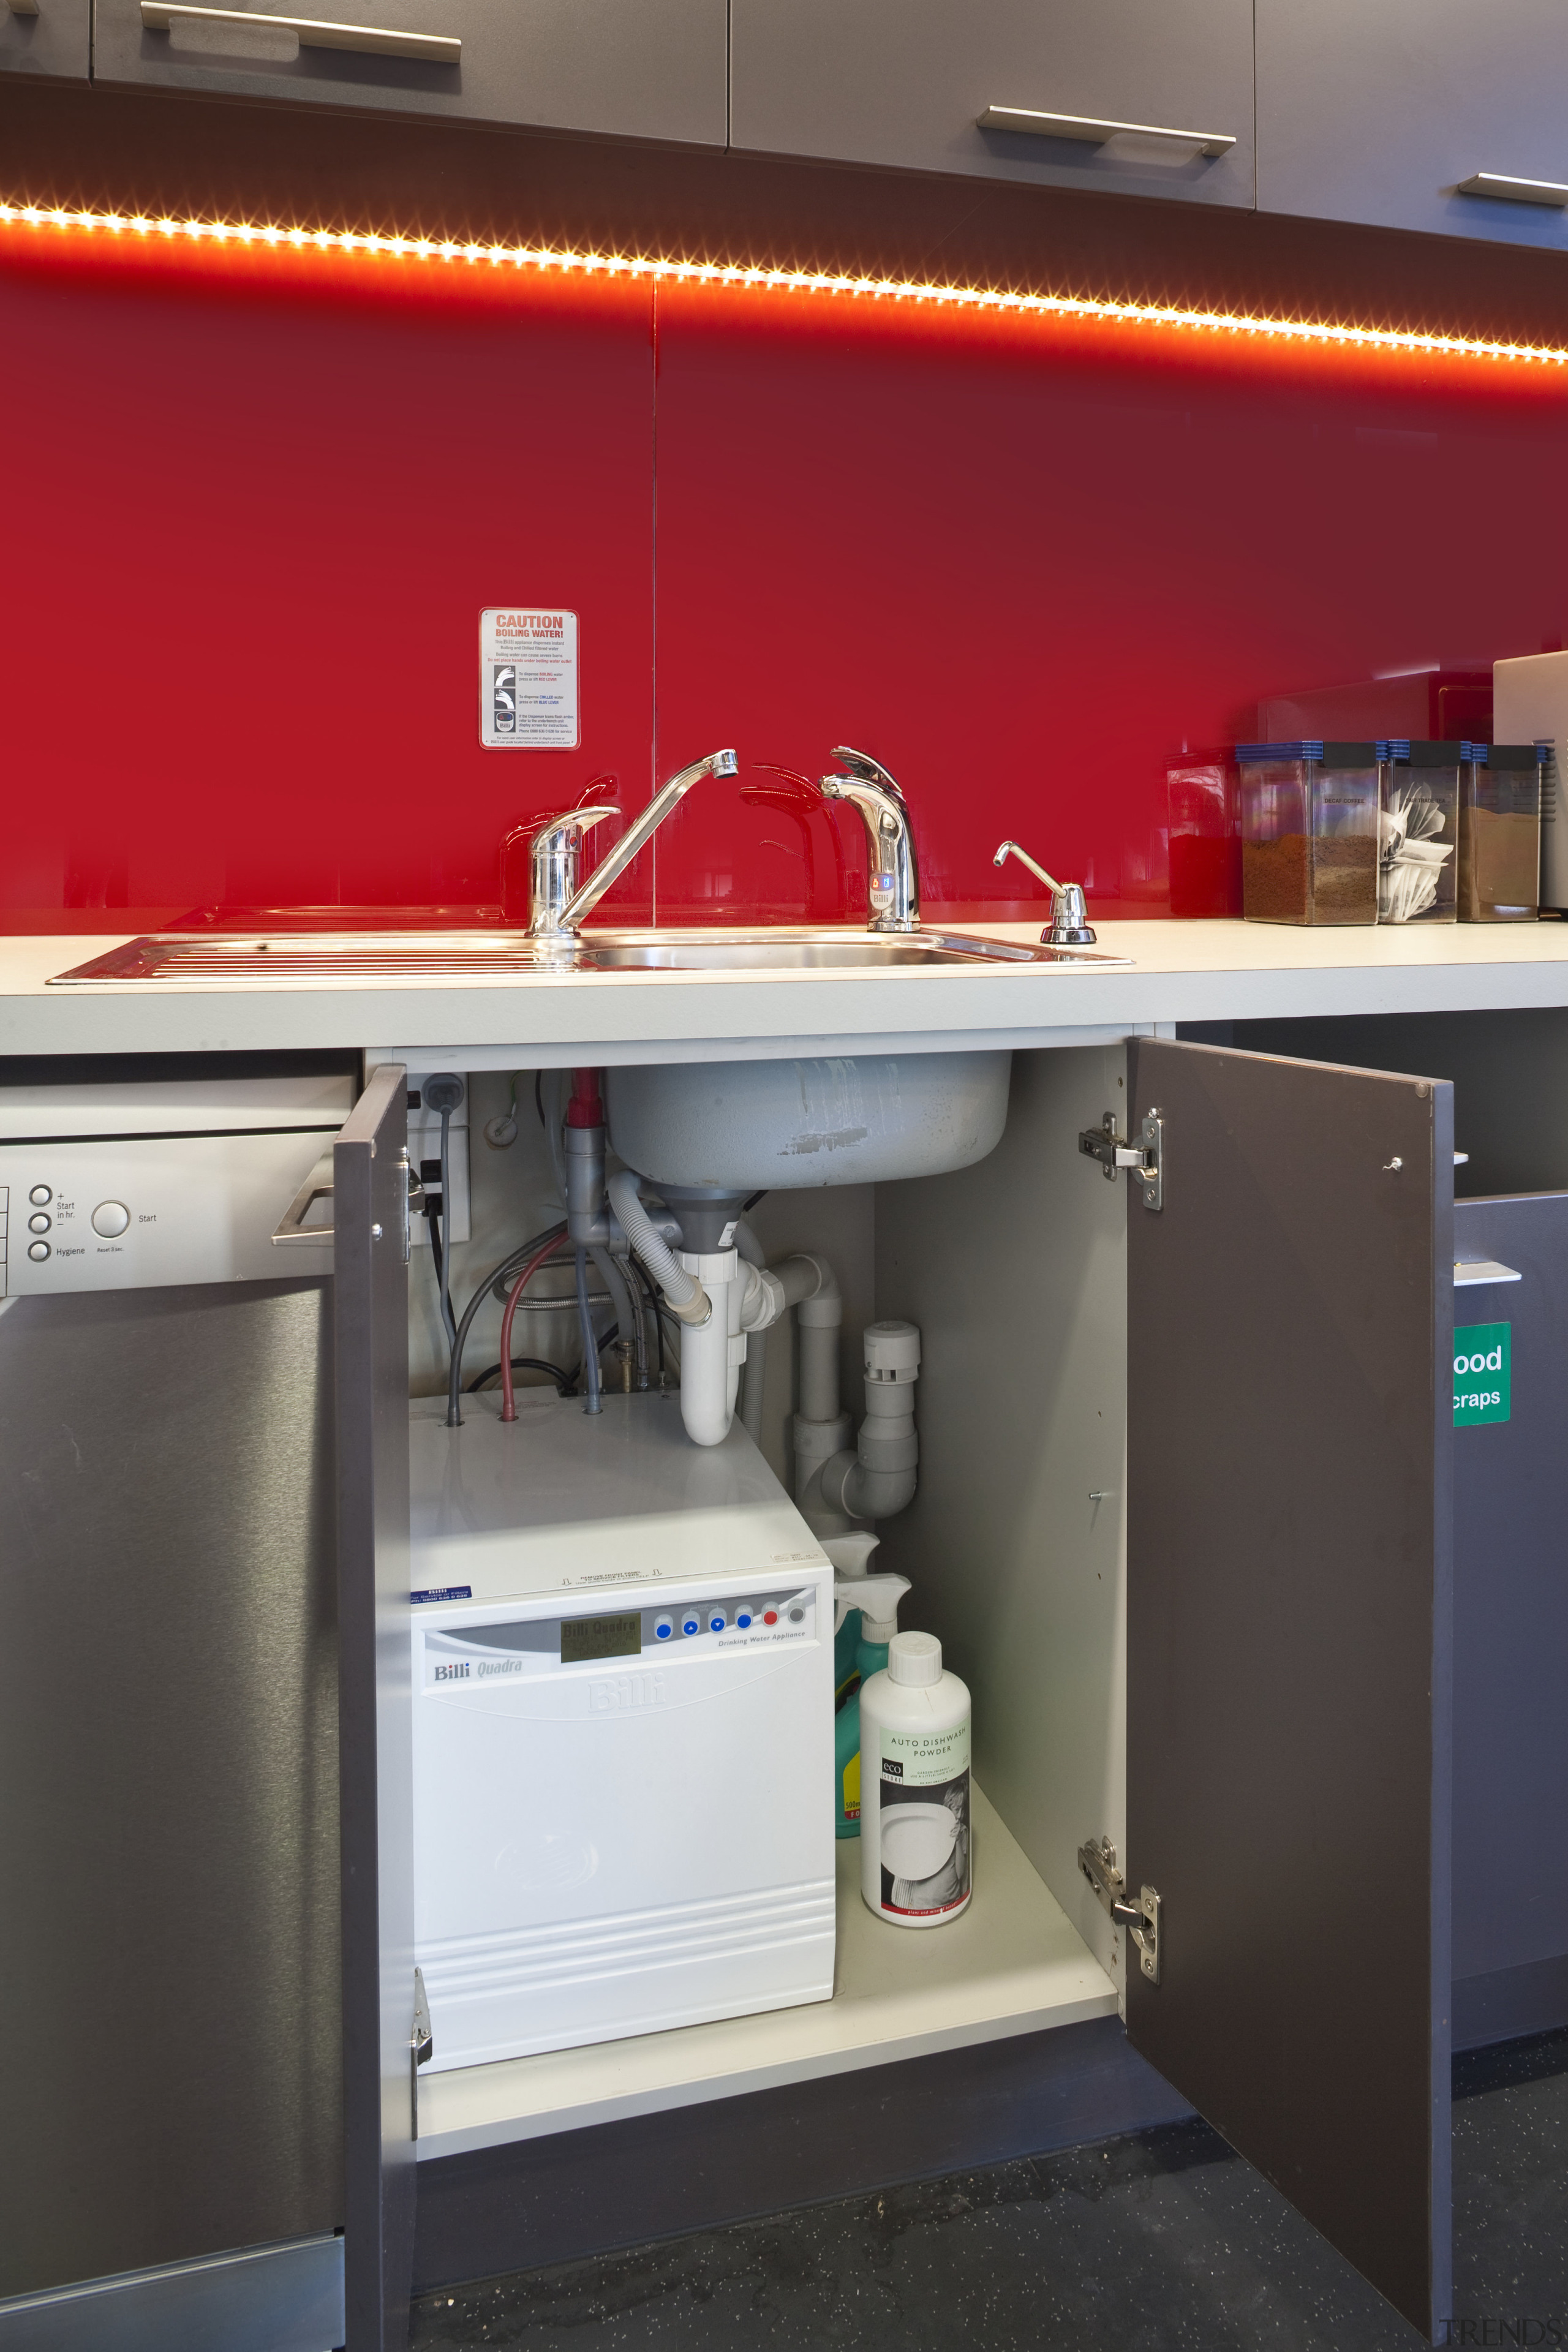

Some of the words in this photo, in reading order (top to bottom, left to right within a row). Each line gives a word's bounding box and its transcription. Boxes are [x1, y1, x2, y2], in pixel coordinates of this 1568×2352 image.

[496, 614, 563, 628] CAUTION
[57, 1248, 85, 1257] Hygiene
[1453, 1345, 1501, 1374] ood
[1453, 1391, 1500, 1410] craps
[563, 1623, 588, 1638] Billi
[593, 1618, 635, 1634] Quadra
[772, 1631, 805, 1640] Appliance
[434, 1662, 470, 1681] Billi
[477, 1659, 522, 1678] Quadra
[588, 1672, 666, 1713] Billi
[891, 1738, 918, 1747] AUTO
[923, 1727, 966, 1746] DISHWASH
[914, 1746, 951, 1757] POWDER
[884, 1763, 901, 1774] eco
[884, 1774, 901, 1782] STORE
